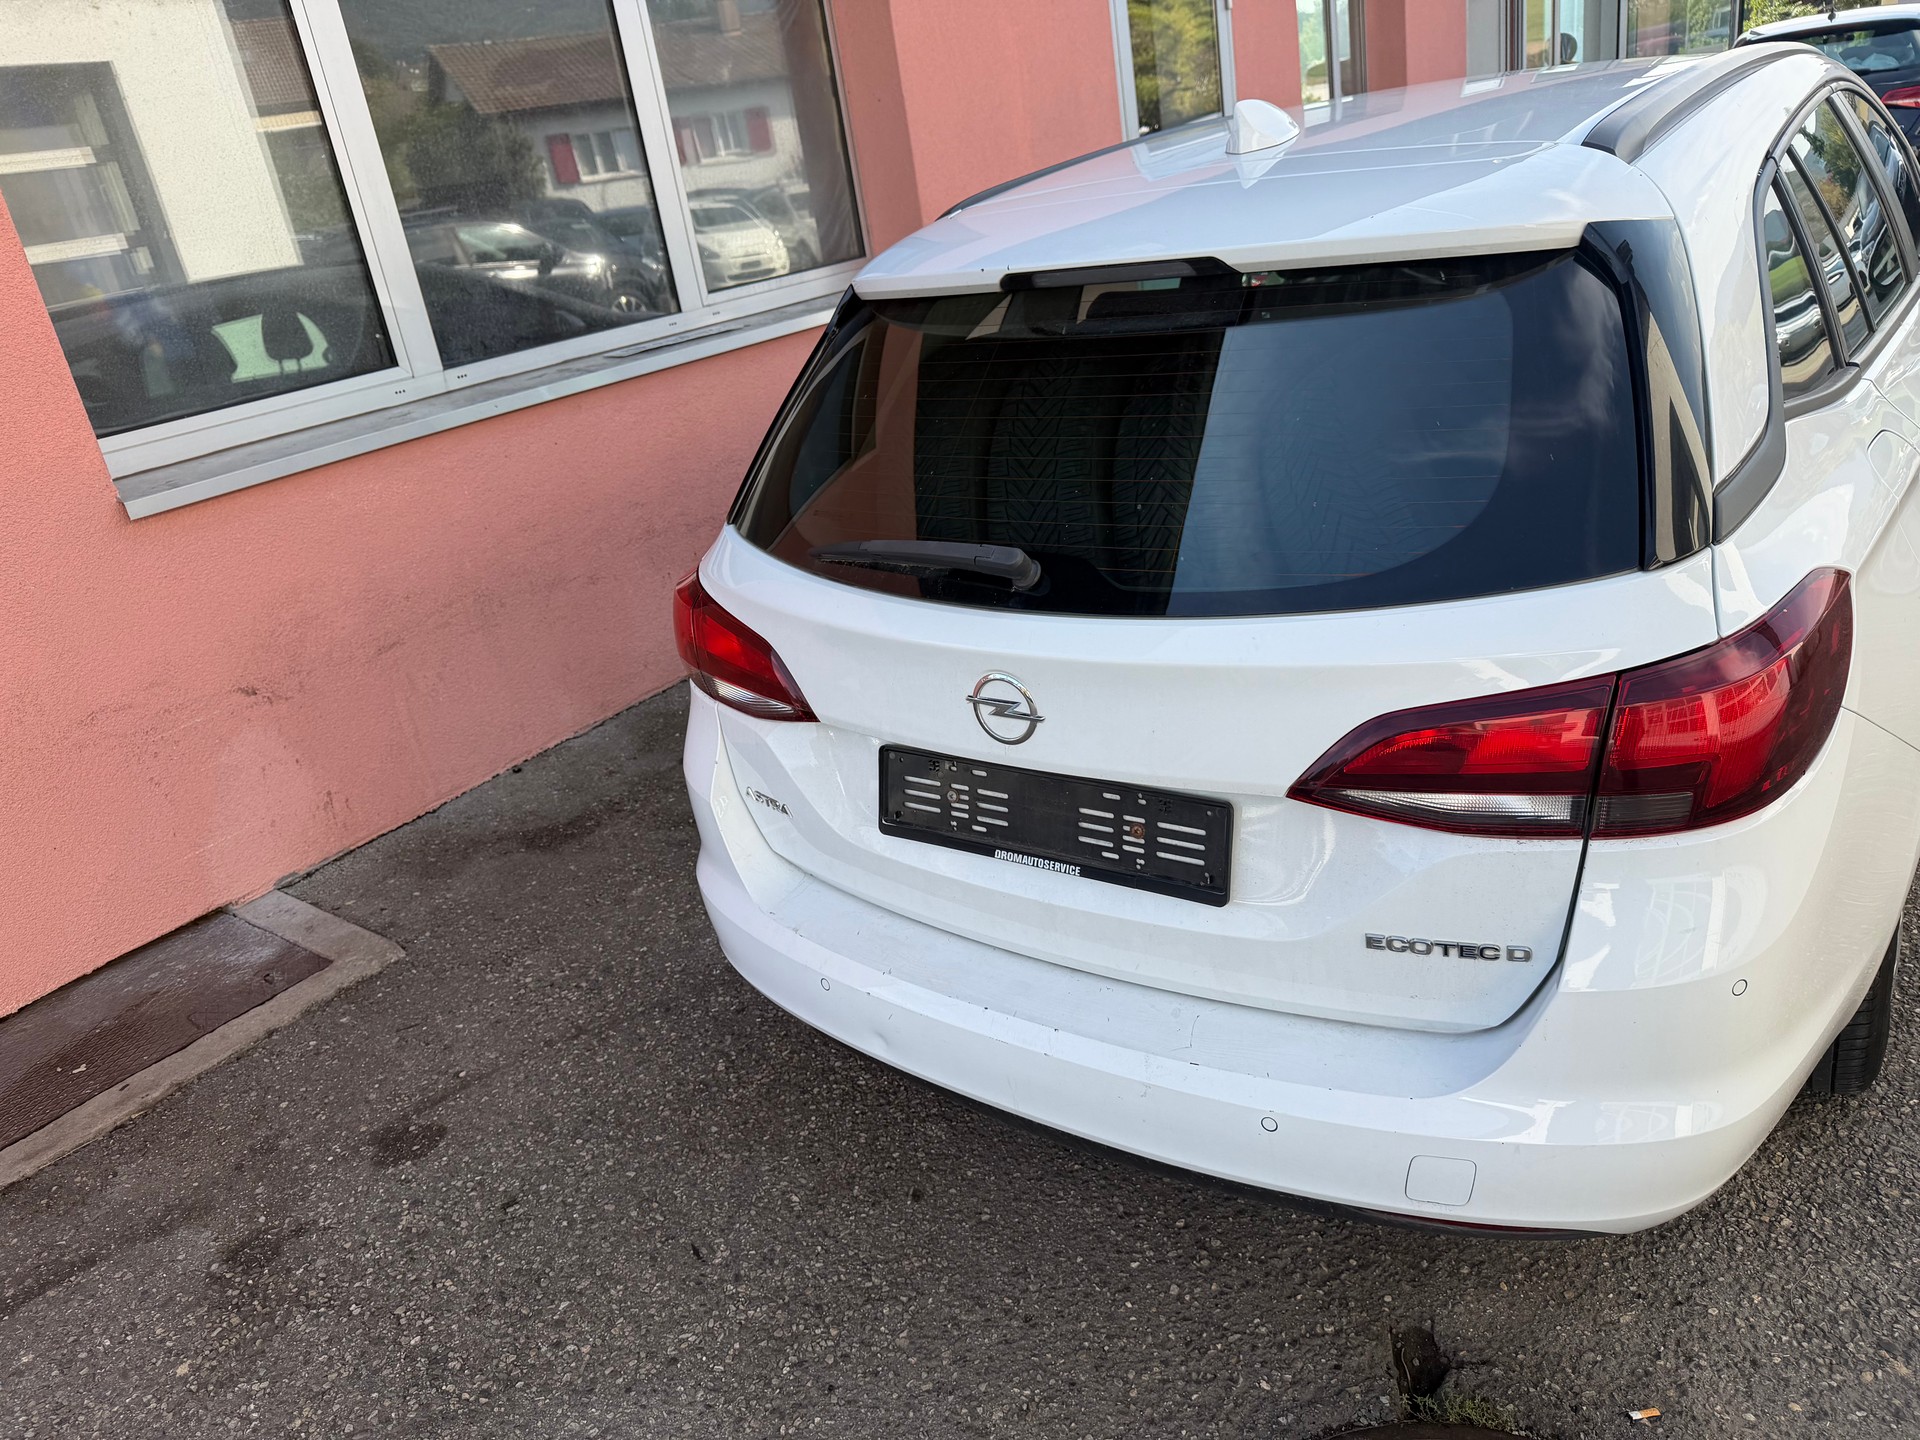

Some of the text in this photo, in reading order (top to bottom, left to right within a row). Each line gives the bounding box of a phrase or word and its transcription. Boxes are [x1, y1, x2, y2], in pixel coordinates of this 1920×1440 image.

[746, 787, 793, 818] ASTRA
[994, 849, 1081, 877] DROMAUTOSERVICE
[1365, 933, 1533, 962] ECOTEC D
